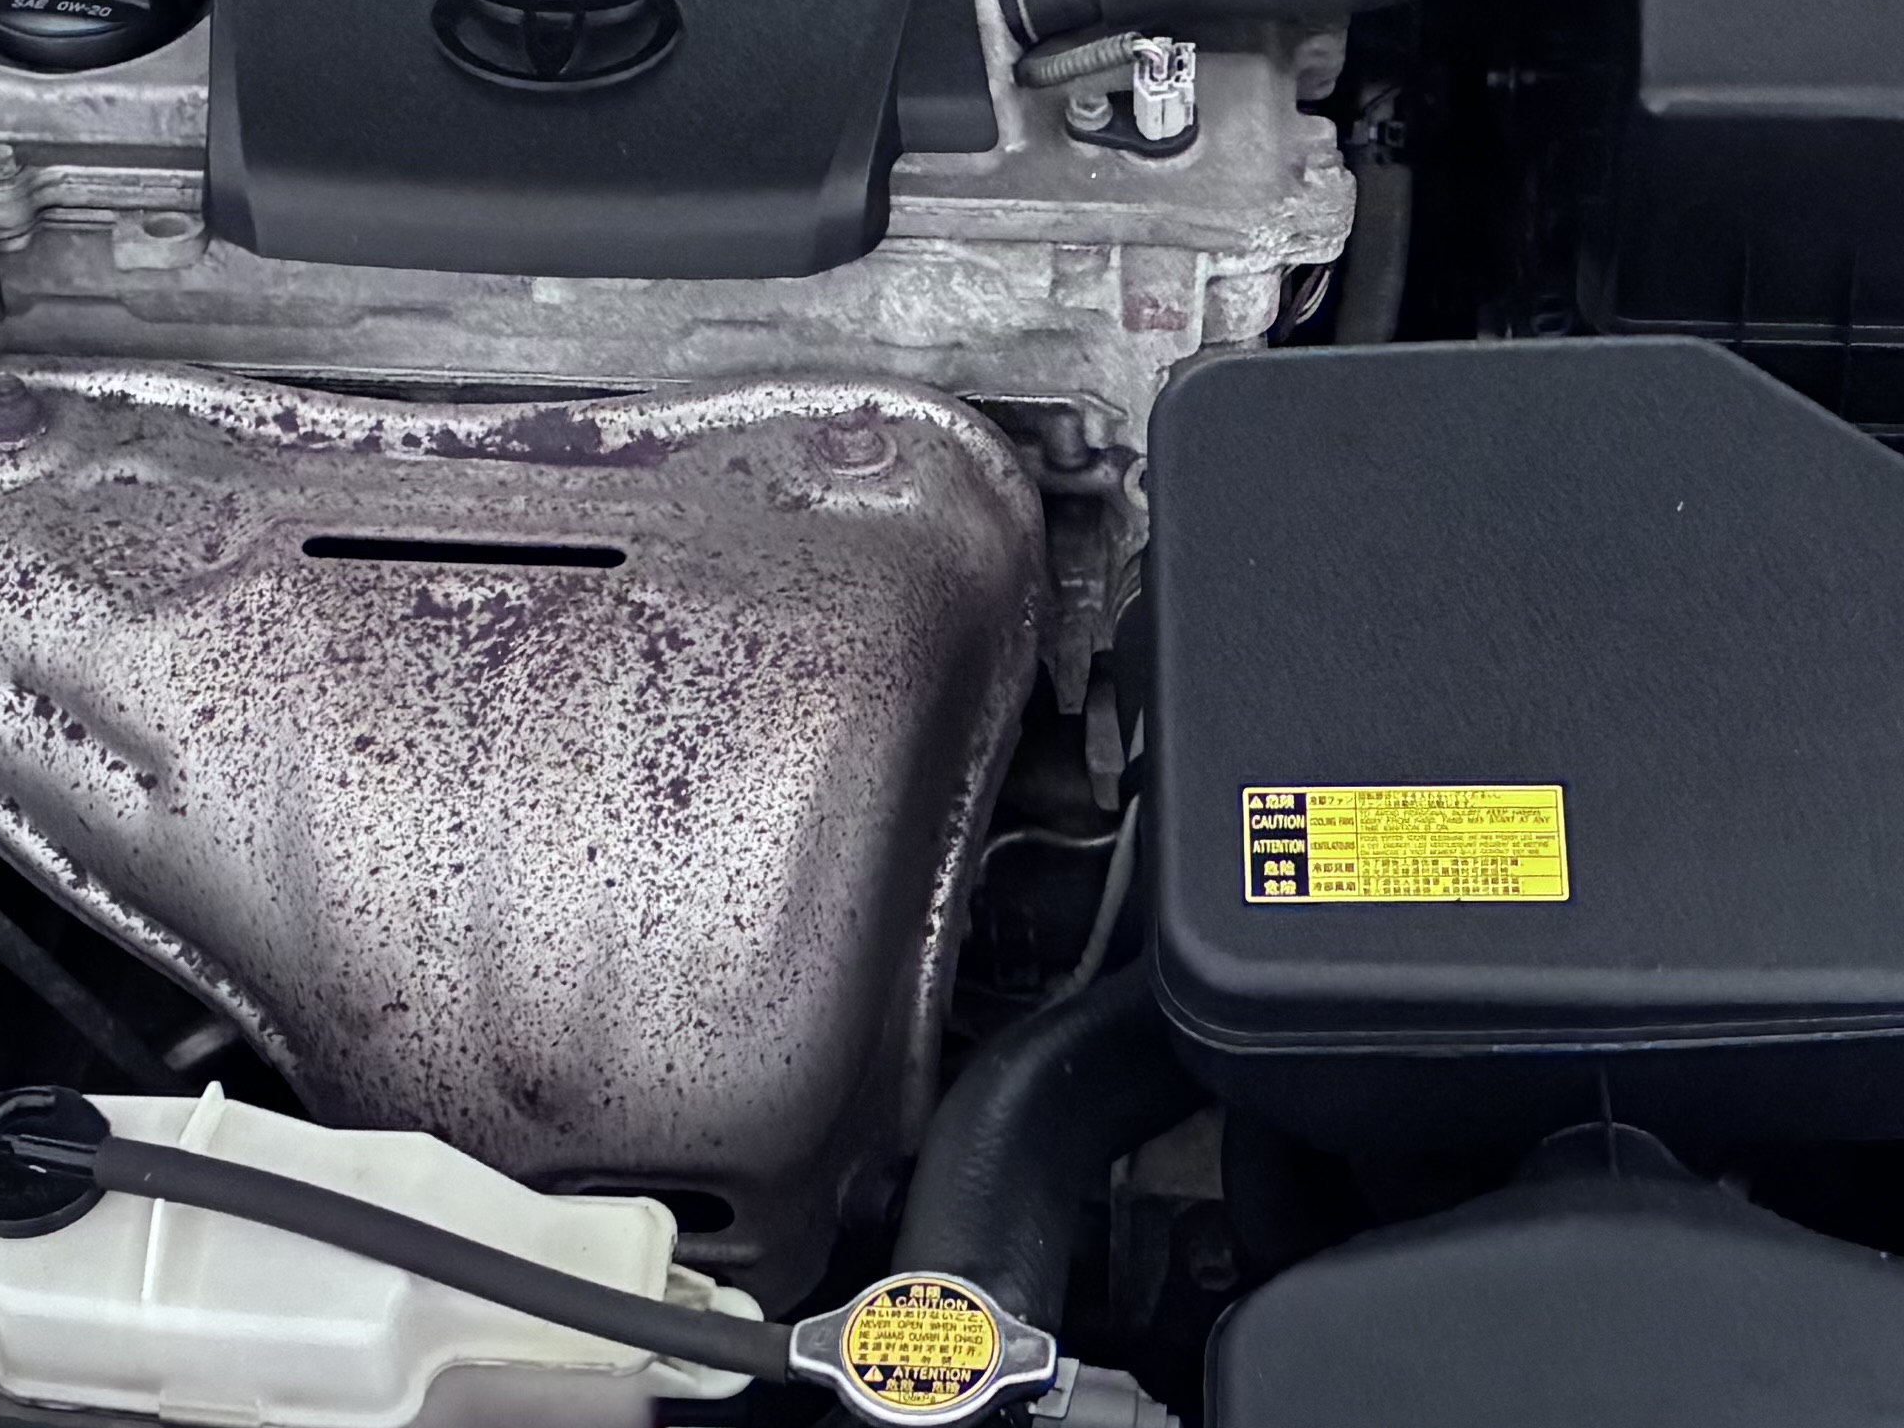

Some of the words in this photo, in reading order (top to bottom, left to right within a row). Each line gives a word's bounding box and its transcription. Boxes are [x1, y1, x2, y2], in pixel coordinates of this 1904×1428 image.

[56, 0, 113, 18] 0W-20
[1251, 815, 1305, 829] CAUTION
[1253, 840, 1305, 854] ATTENTION
[895, 1297, 968, 1310] CAUTION
[898, 1321, 923, 1329] OPEN
[893, 1366, 971, 1382] ATTENTION
